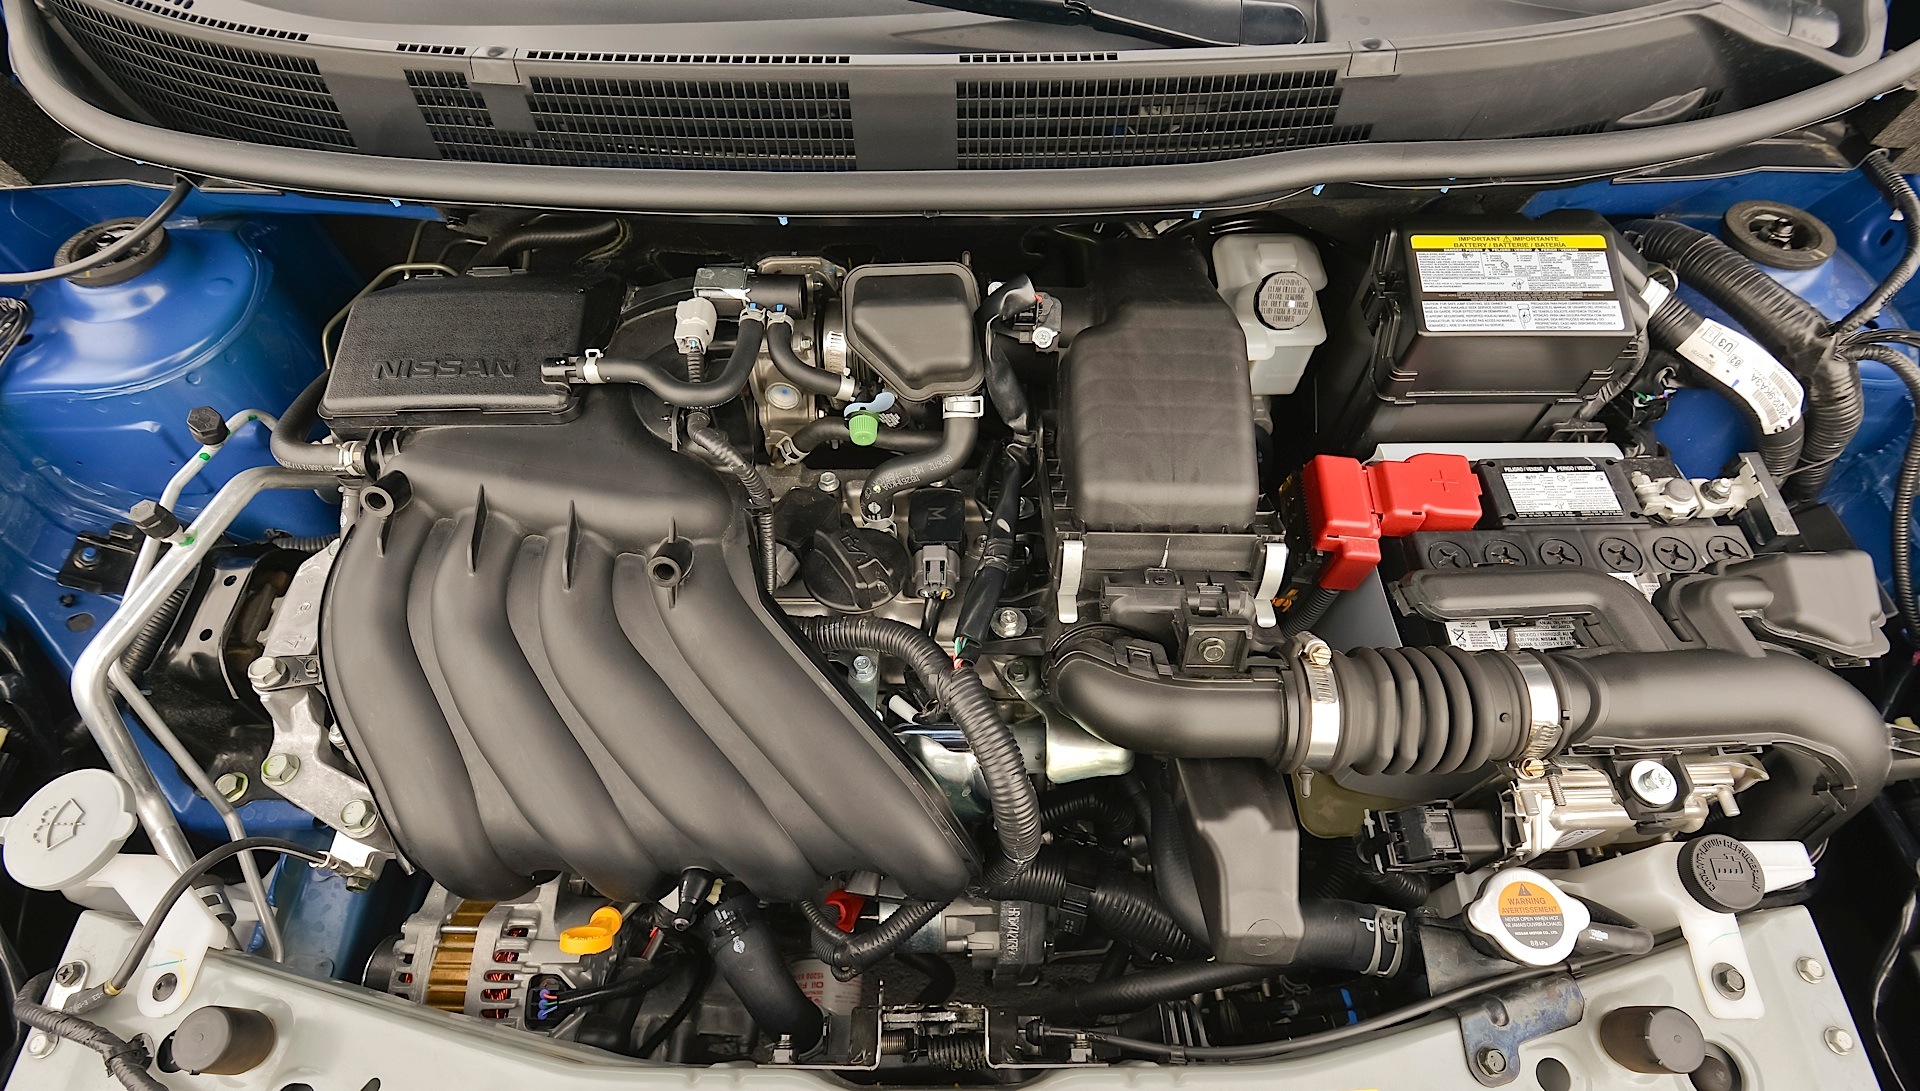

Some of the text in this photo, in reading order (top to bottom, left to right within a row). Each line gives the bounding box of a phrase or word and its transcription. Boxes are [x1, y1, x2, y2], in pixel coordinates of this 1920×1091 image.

[1718, 338, 1734, 353] U3
[1729, 356, 1741, 367] 02
[373, 358, 518, 380] NISSAN
[1502, 906, 1557, 914] AVERTISSEMENT
